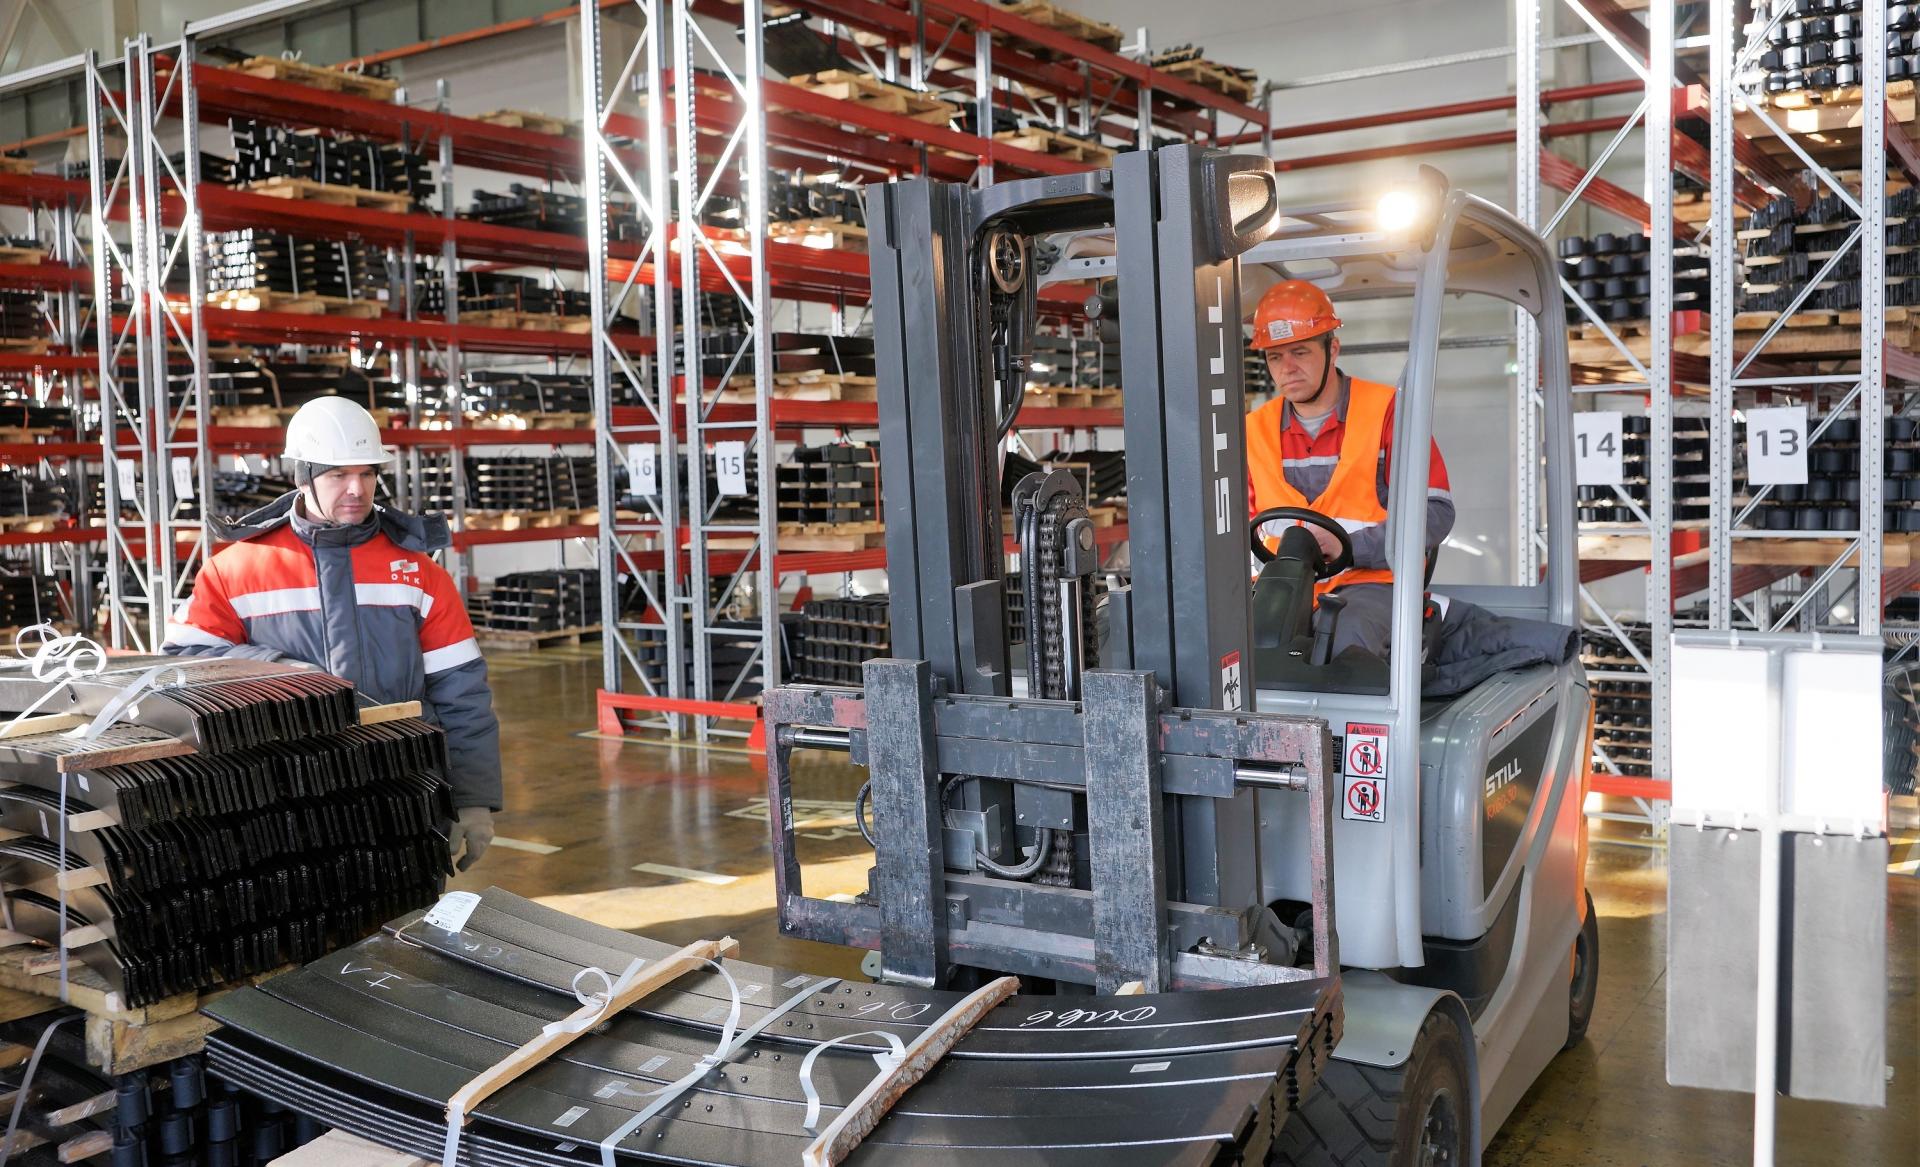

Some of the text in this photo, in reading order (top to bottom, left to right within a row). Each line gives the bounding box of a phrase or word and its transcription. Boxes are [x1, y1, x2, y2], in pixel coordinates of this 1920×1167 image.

[1208, 276, 1230, 535] STILL
[1577, 432, 1616, 458] 14
[1756, 428, 1799, 456] 13
[633, 458, 652, 476] 16
[721, 456, 740, 475] 15
[1485, 757, 1522, 798] STILL
